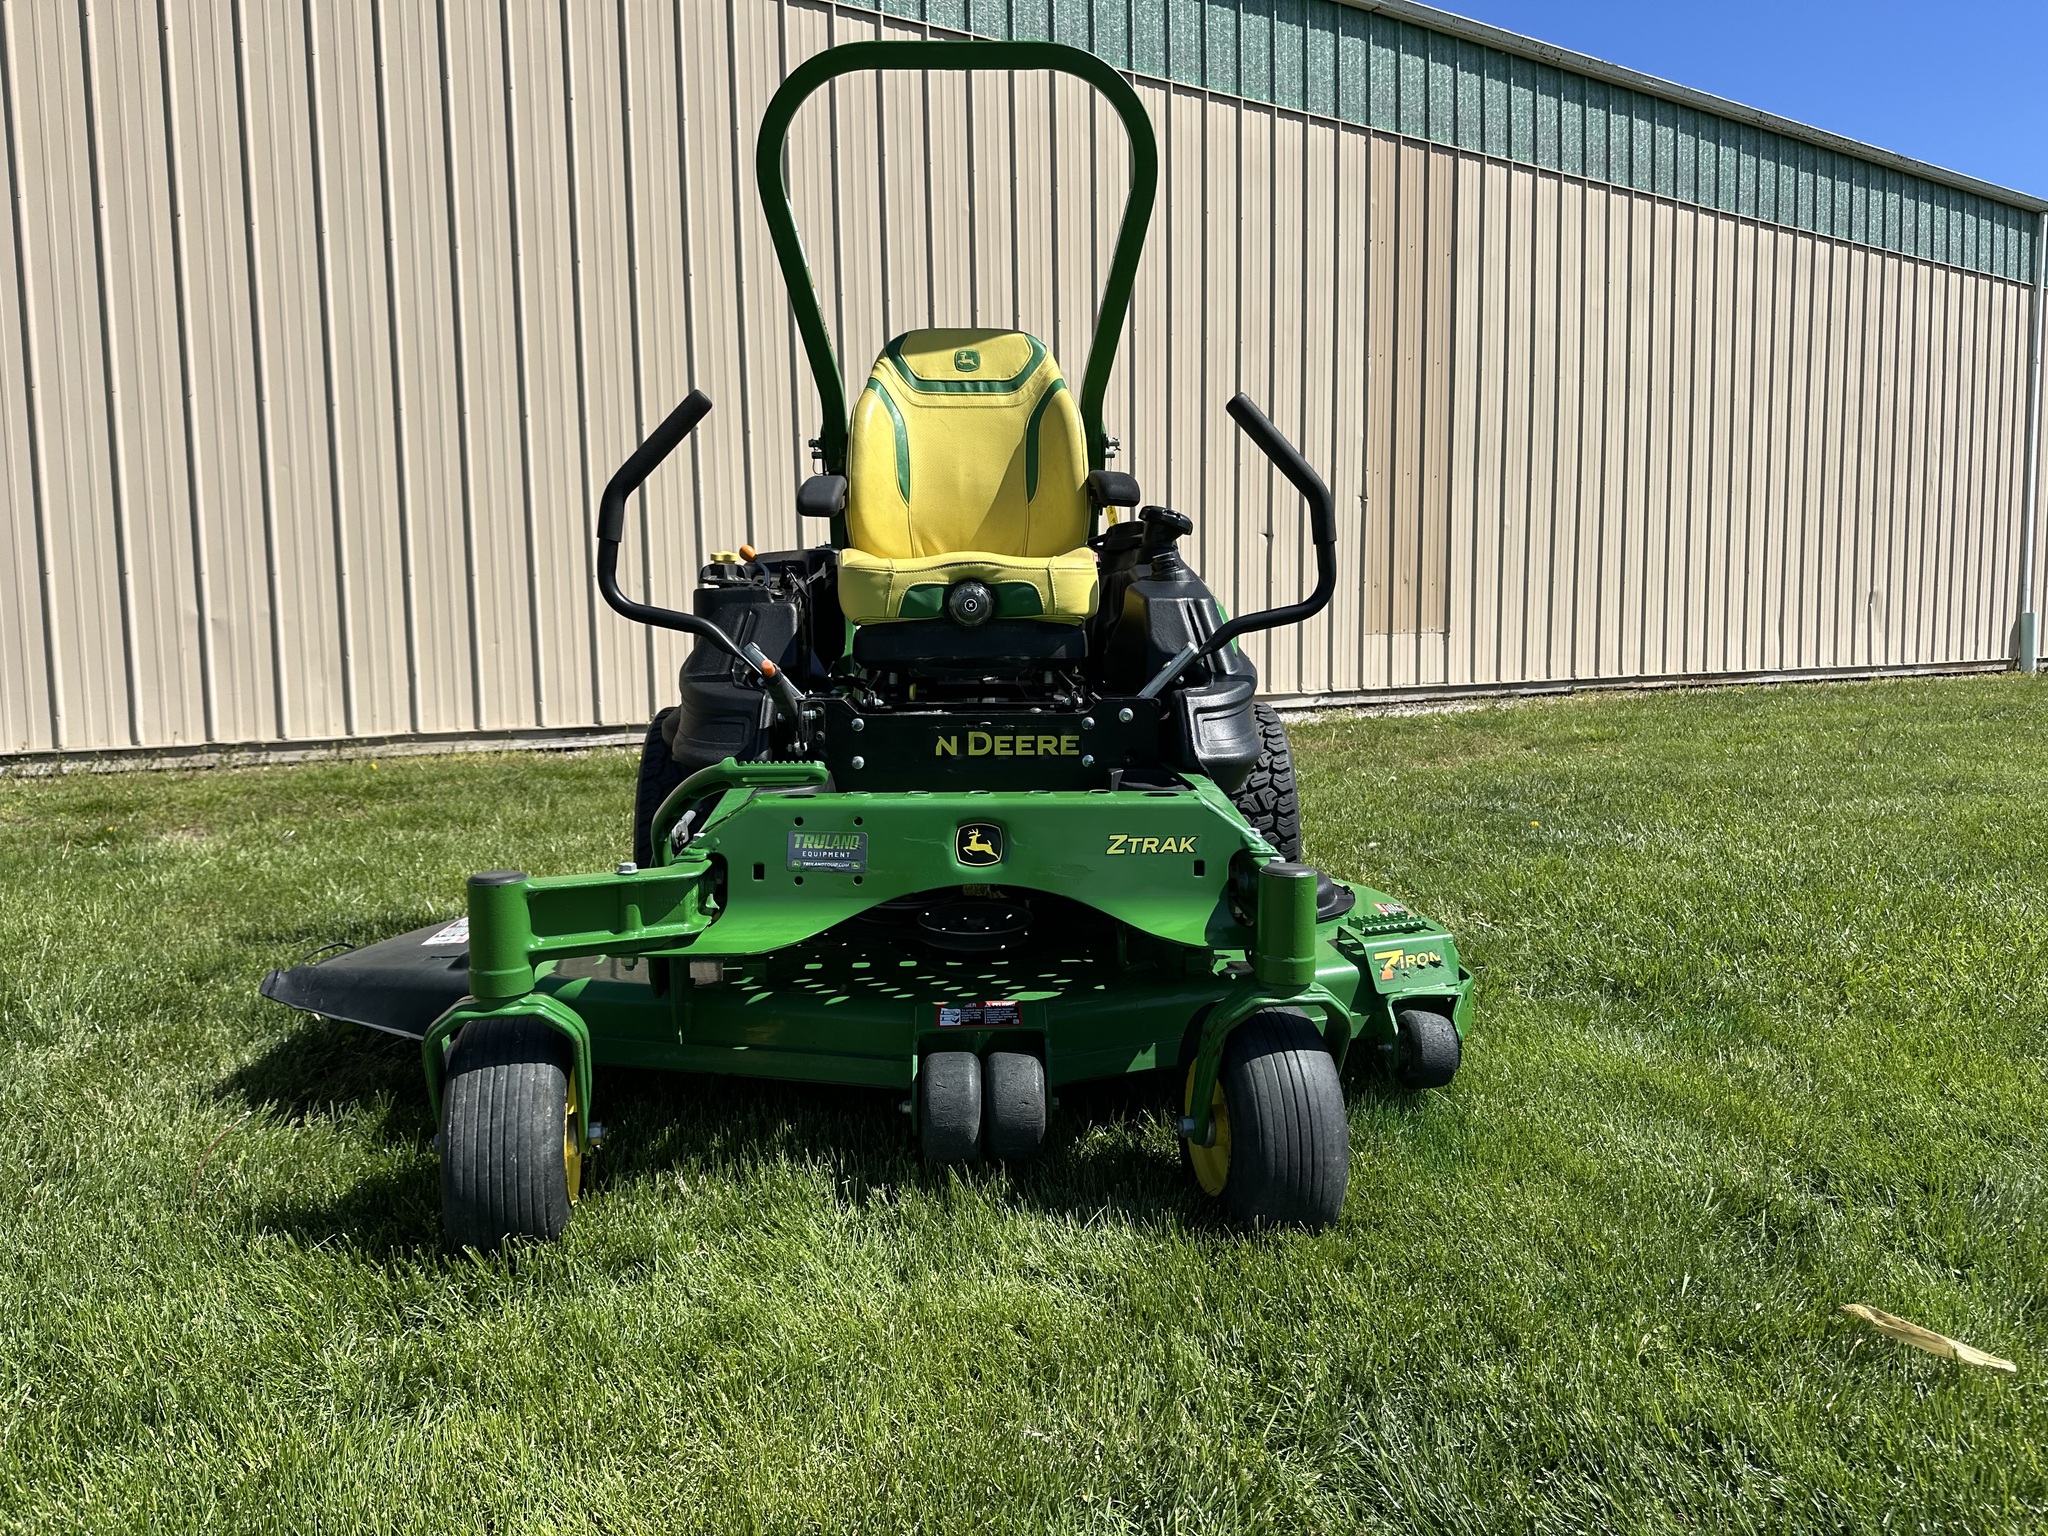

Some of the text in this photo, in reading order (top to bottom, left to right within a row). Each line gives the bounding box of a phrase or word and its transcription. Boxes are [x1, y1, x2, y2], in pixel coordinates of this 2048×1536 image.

[968, 731, 1080, 756] DEERE
[794, 833, 860, 850] TRULAND
[1106, 834, 1197, 855] ZTRAK
